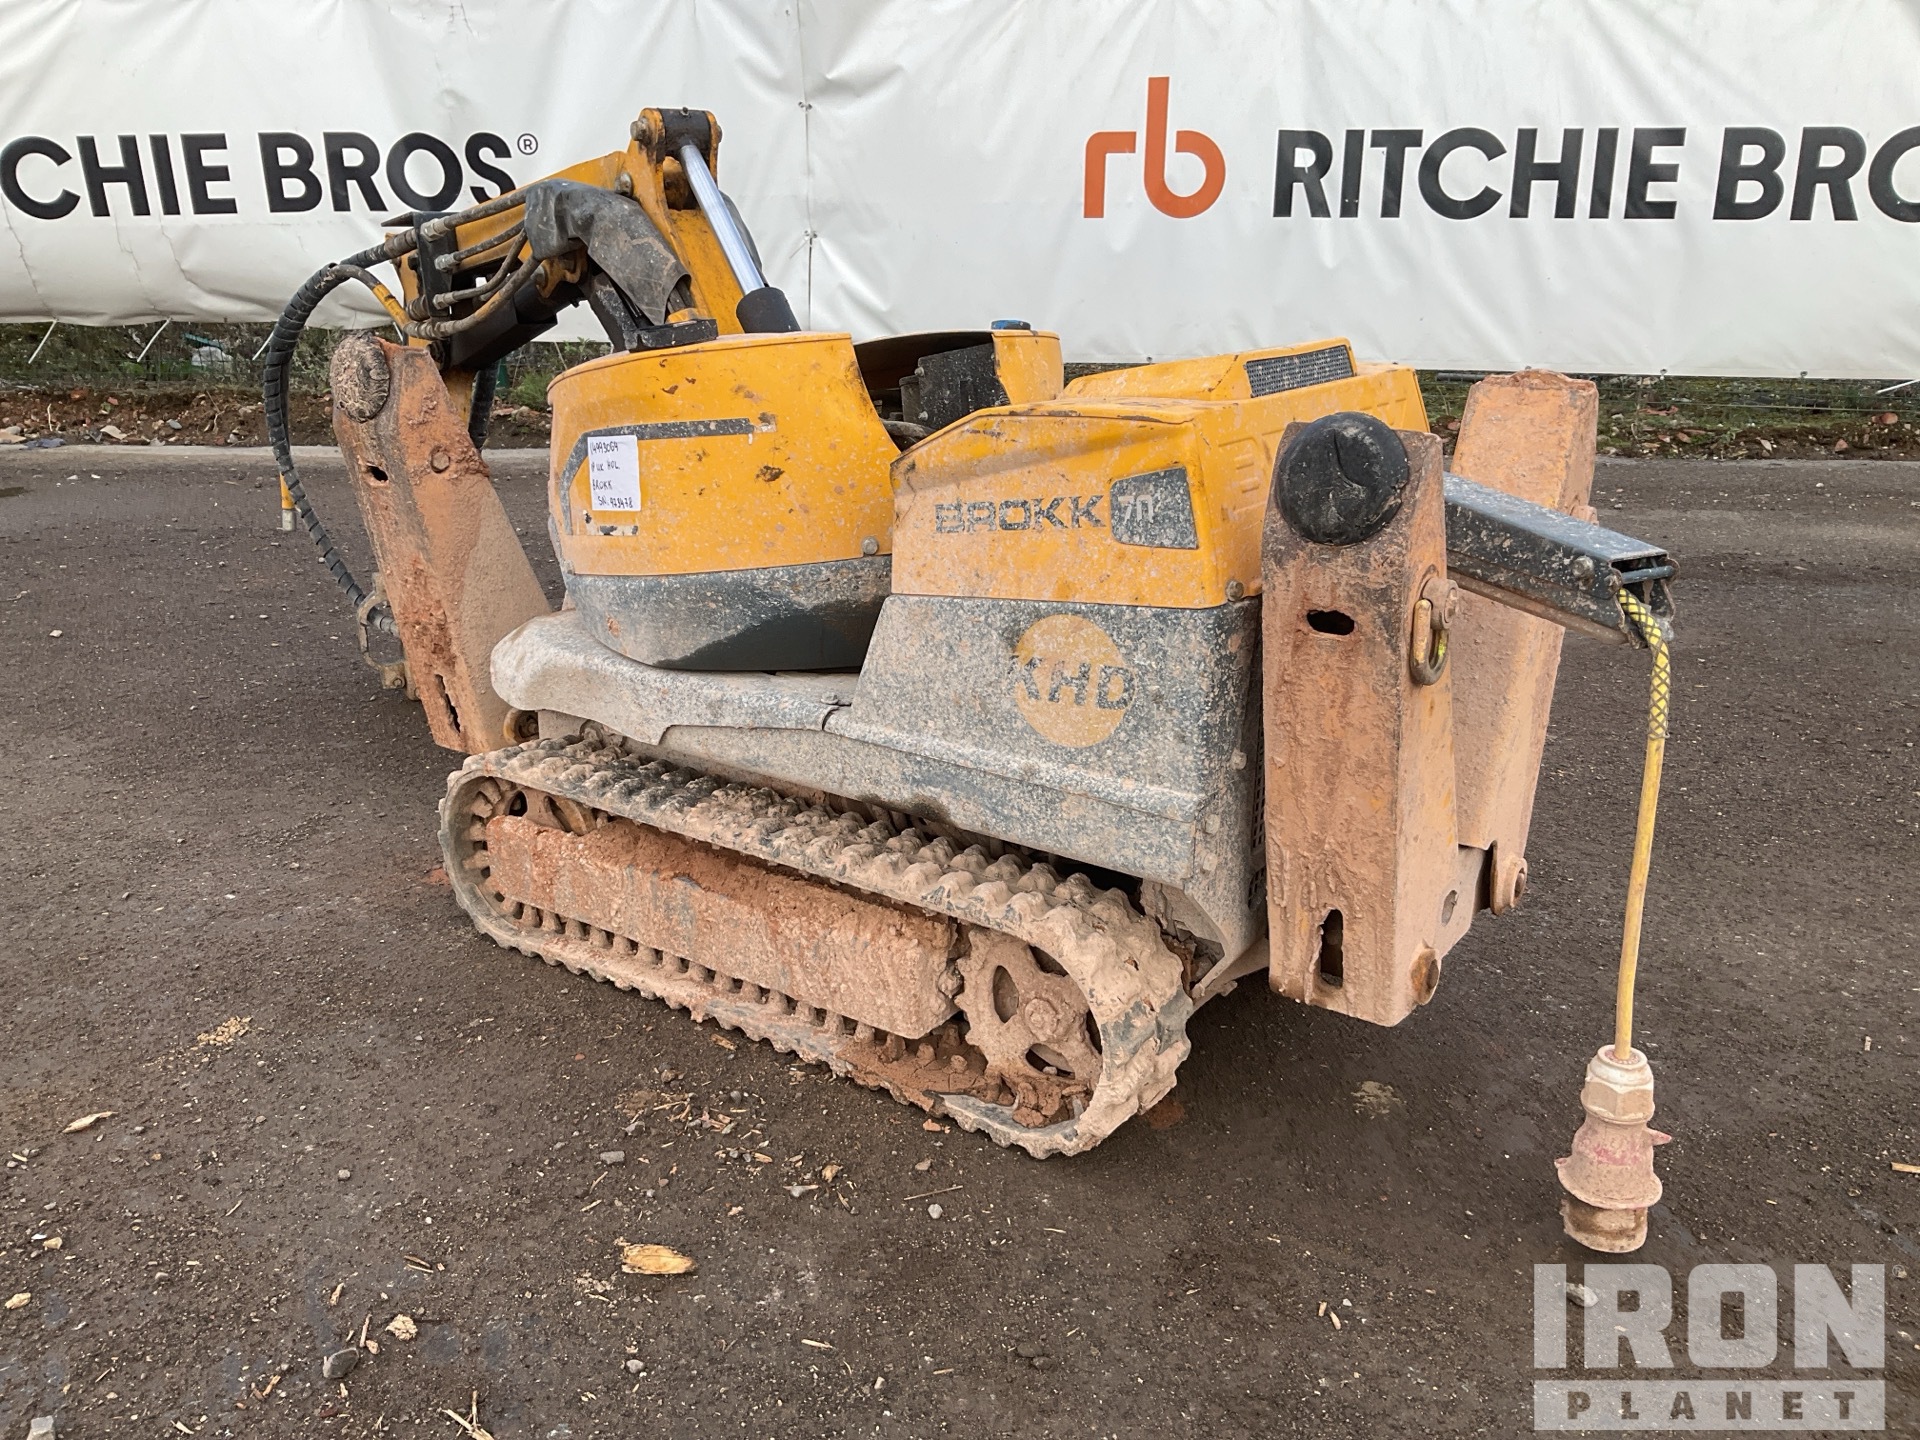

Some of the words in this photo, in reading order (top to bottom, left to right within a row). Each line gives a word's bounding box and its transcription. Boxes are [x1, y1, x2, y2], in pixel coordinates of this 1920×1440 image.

[1273, 127, 1686, 219] RITCHIE
[592, 479, 613, 490] BROKK
[934, 494, 1106, 534] BROKK
